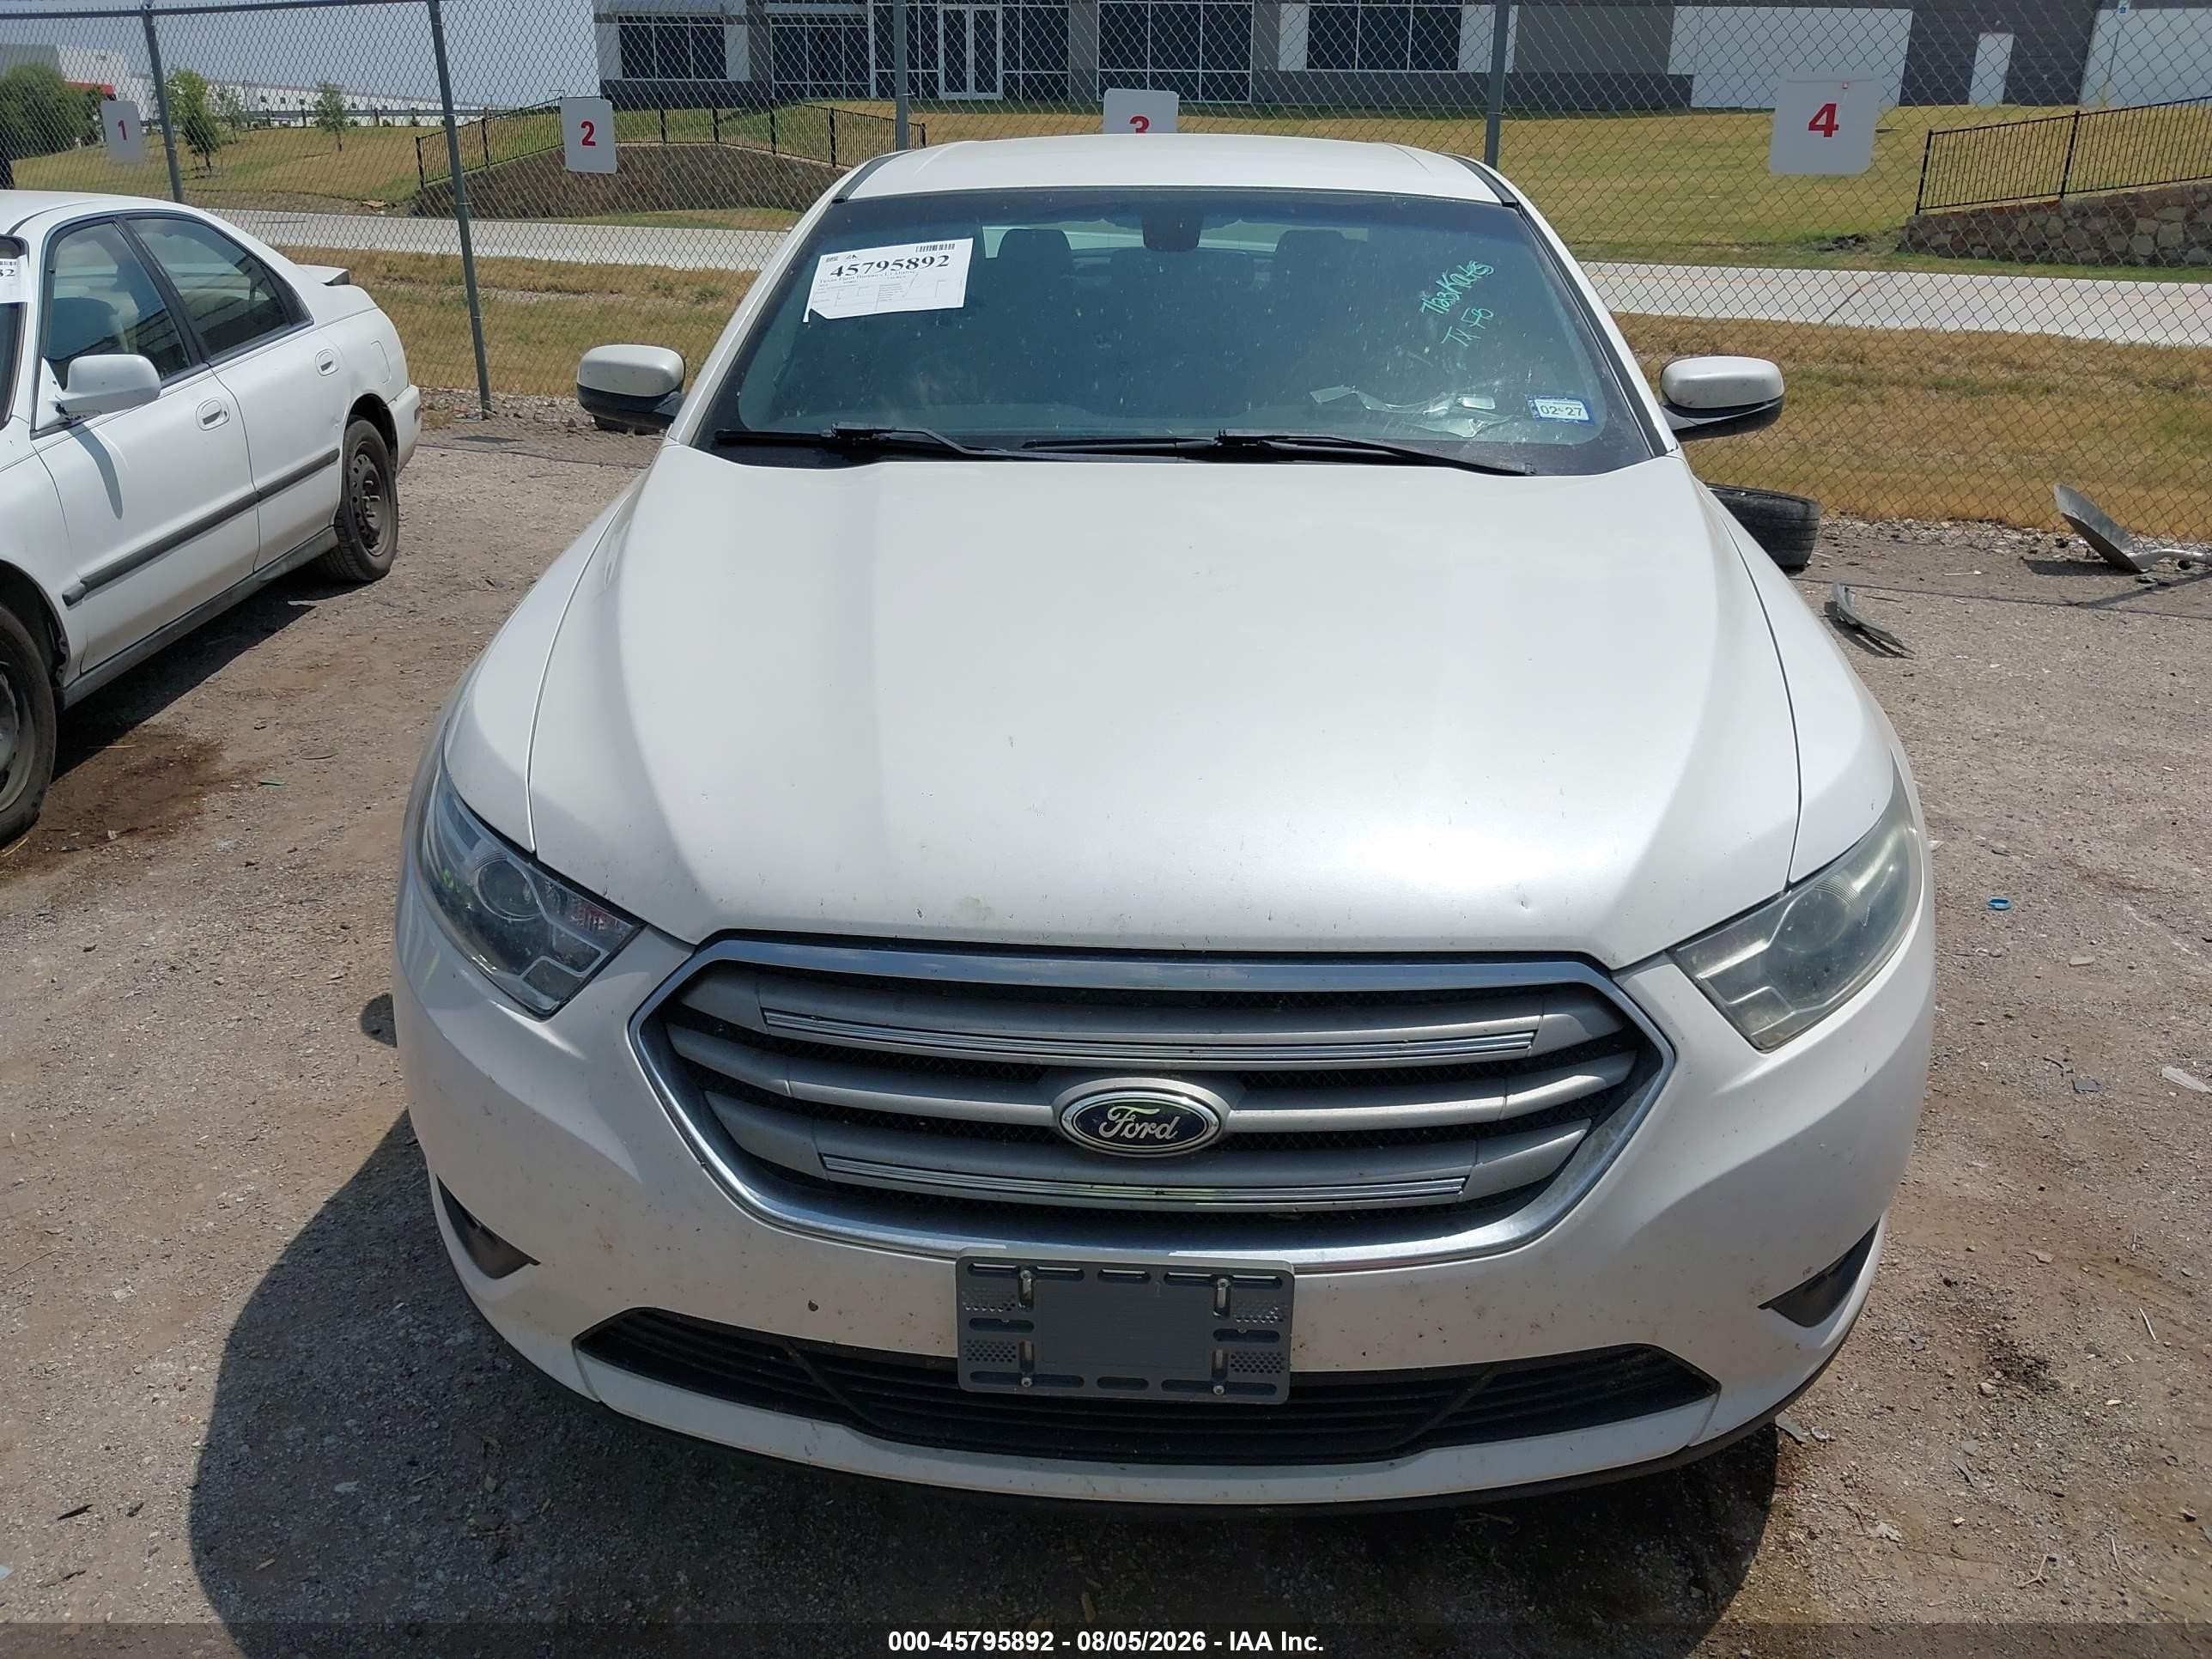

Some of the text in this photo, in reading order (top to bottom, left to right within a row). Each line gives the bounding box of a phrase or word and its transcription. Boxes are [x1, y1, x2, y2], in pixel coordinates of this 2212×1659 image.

[118, 119, 127, 141] 1
[1808, 102, 1839, 137] 4
[580, 120, 596, 147] 2
[830, 254, 950, 277] 45795892
[1540, 405, 1583, 416] 02 27
[1098, 1105, 1181, 1139] Ford
